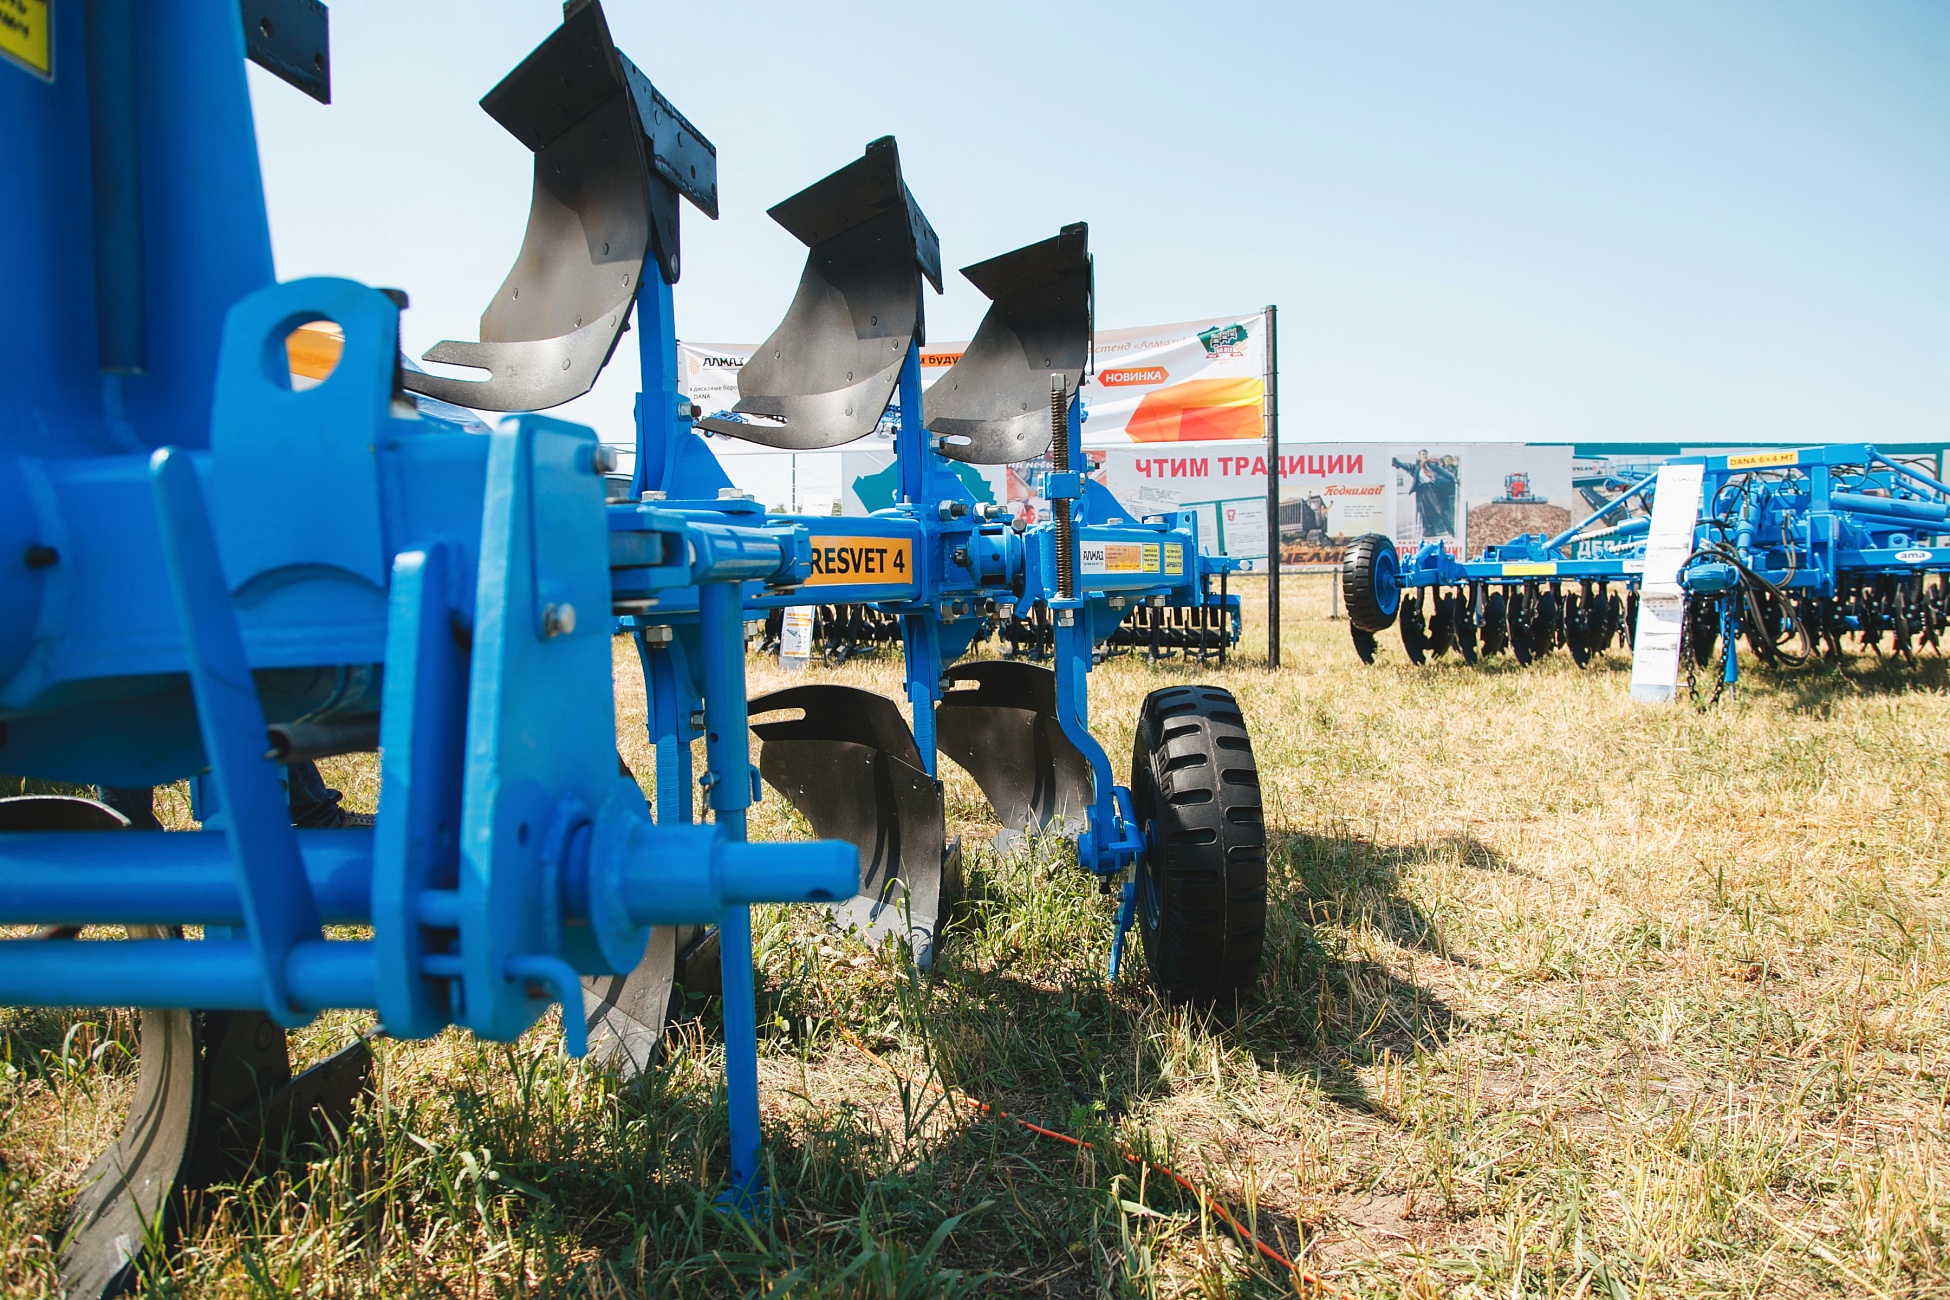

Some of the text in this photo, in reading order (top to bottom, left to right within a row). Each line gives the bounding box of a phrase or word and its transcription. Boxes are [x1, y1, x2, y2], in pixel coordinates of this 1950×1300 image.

[703, 357, 744, 367] АЛМАЗ
[929, 355, 961, 366] буду
[1105, 370, 1162, 383] НОВИНКА
[1135, 457, 1209, 478] ЧТИМ
[1730, 457, 1756, 467] DANA
[1324, 485, 1385, 497] Поднимай
[893, 548, 905, 574] 4
